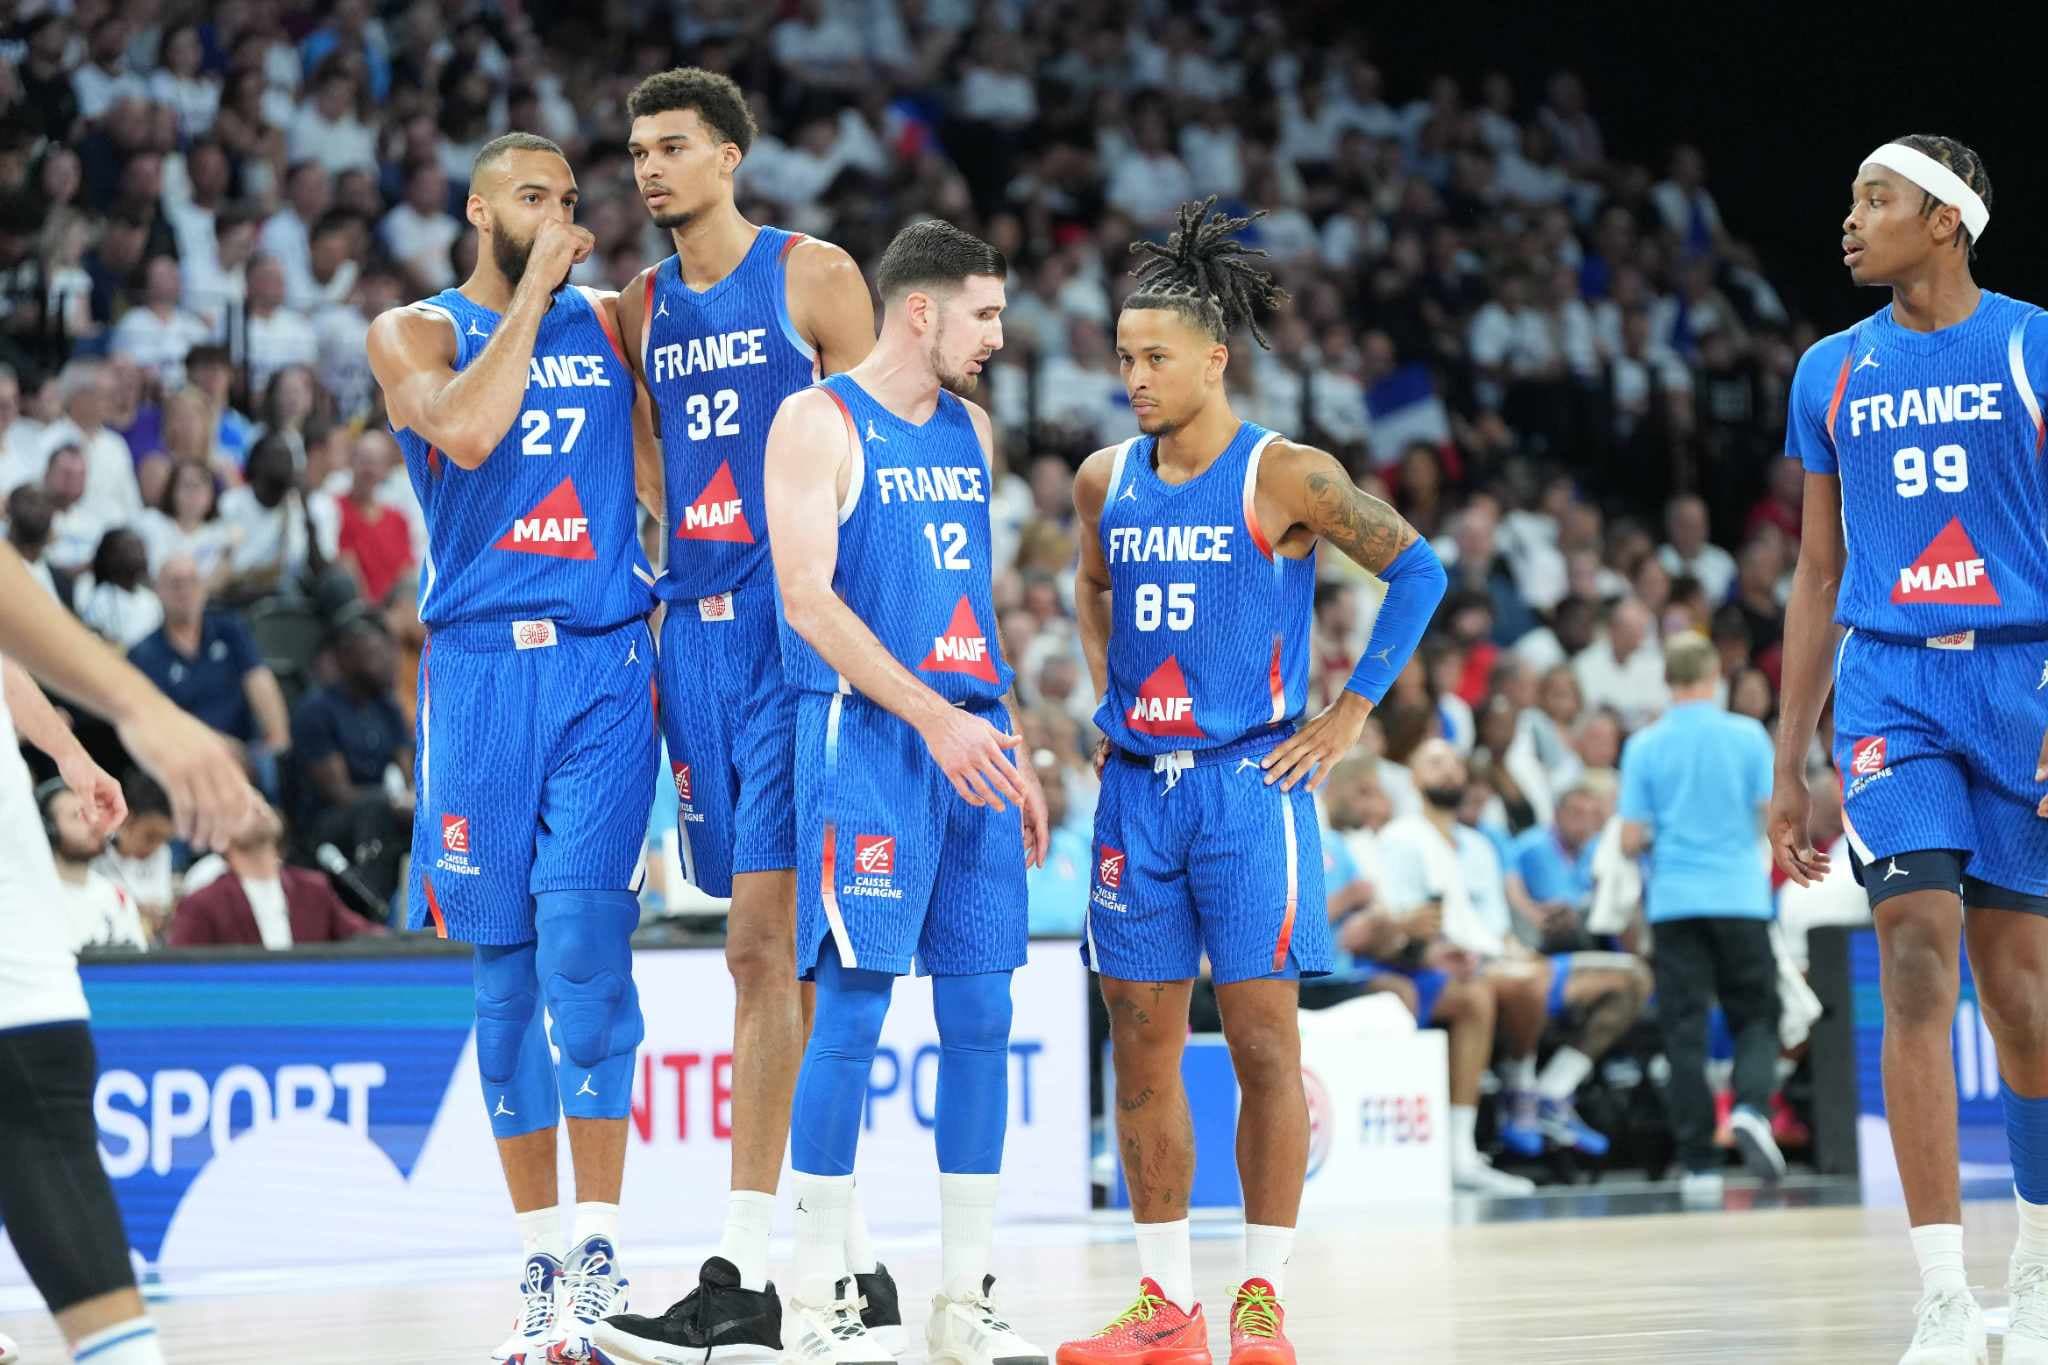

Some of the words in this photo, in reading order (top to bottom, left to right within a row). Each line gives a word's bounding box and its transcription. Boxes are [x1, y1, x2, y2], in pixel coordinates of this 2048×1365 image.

[525, 354, 611, 390] ANCE
[653, 329, 767, 383] FRANCE
[687, 388, 740, 441] 32
[1851, 382, 2003, 437] FRANCE
[521, 407, 586, 456] 27
[876, 466, 985, 505] FRANCE
[1893, 444, 1969, 498] 99
[513, 517, 589, 543] MAIF
[685, 498, 743, 530] MAIF
[923, 522, 971, 571] 12
[1109, 525, 1234, 564] FRANCE
[1900, 558, 1985, 594] MAIF
[1135, 582, 1196, 632] 85
[934, 635, 987, 662] MAIF
[1131, 696, 1194, 722] MAIF
[855, 876, 892, 888] CAISSE
